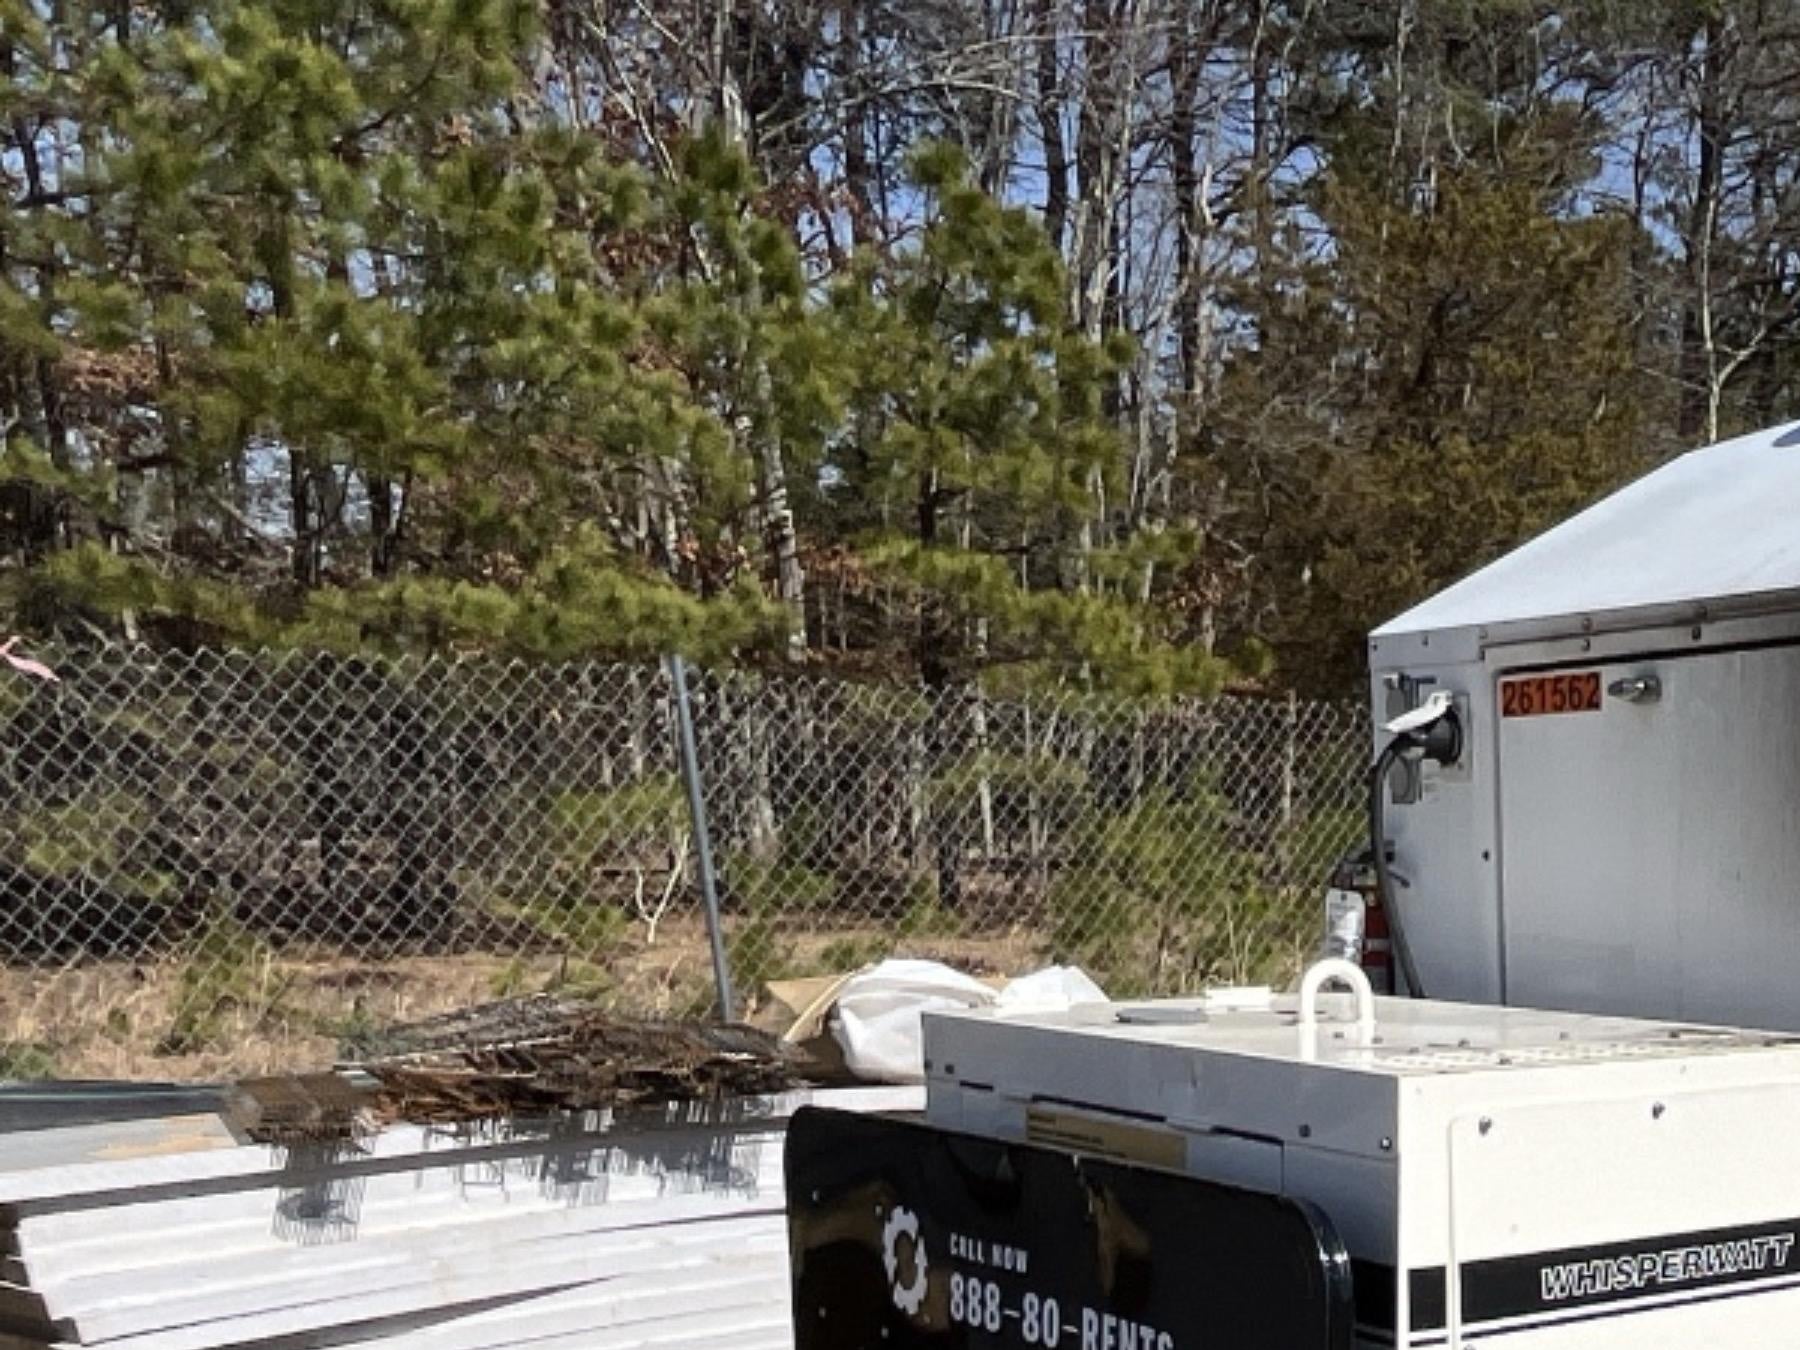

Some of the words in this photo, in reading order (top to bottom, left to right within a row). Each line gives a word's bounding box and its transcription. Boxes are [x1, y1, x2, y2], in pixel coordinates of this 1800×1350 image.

[1502, 672, 1601, 718] 261562
[950, 1231, 985, 1265] CALL
[991, 1243, 1029, 1274] NOW
[1541, 1232, 1796, 1301] WHISPERWATT
